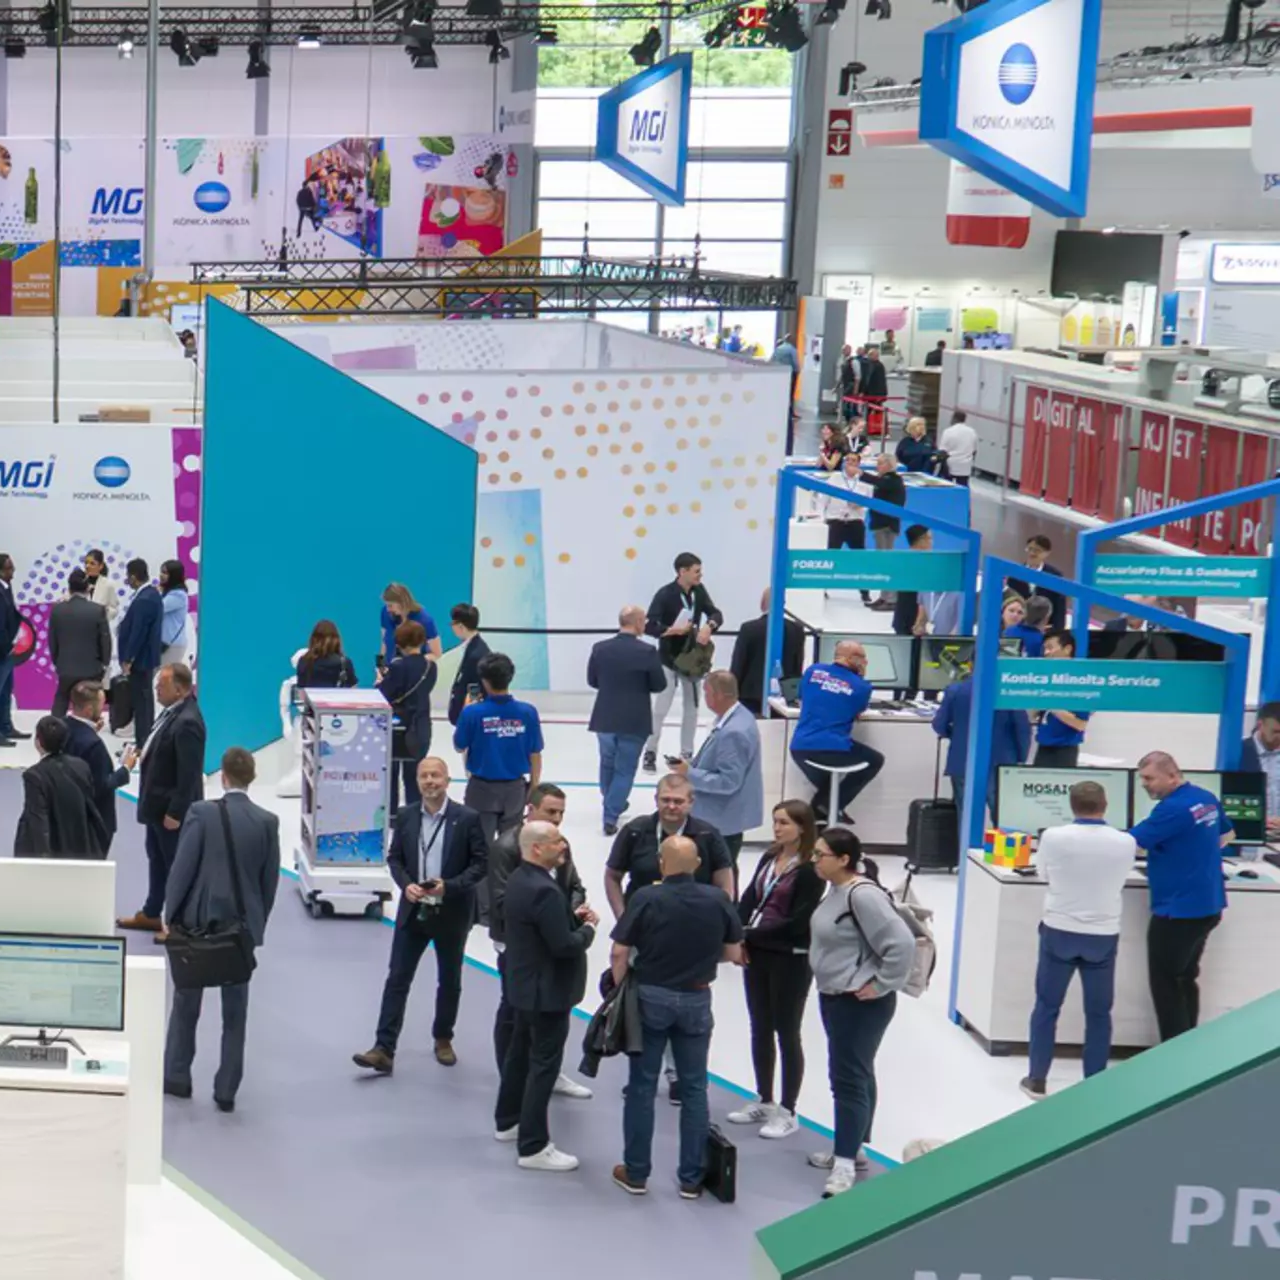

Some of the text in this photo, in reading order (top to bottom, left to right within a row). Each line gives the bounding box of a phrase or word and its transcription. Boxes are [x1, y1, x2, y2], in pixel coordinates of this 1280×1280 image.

[972, 115, 1056, 131] KONICA MINOLTA
[91, 187, 145, 215] MG
[172, 218, 251, 226] KONICA MINOLTA
[73, 492, 151, 501] KONICA MINOLTA
[1001, 672, 1161, 687] Konica Minolta Service
